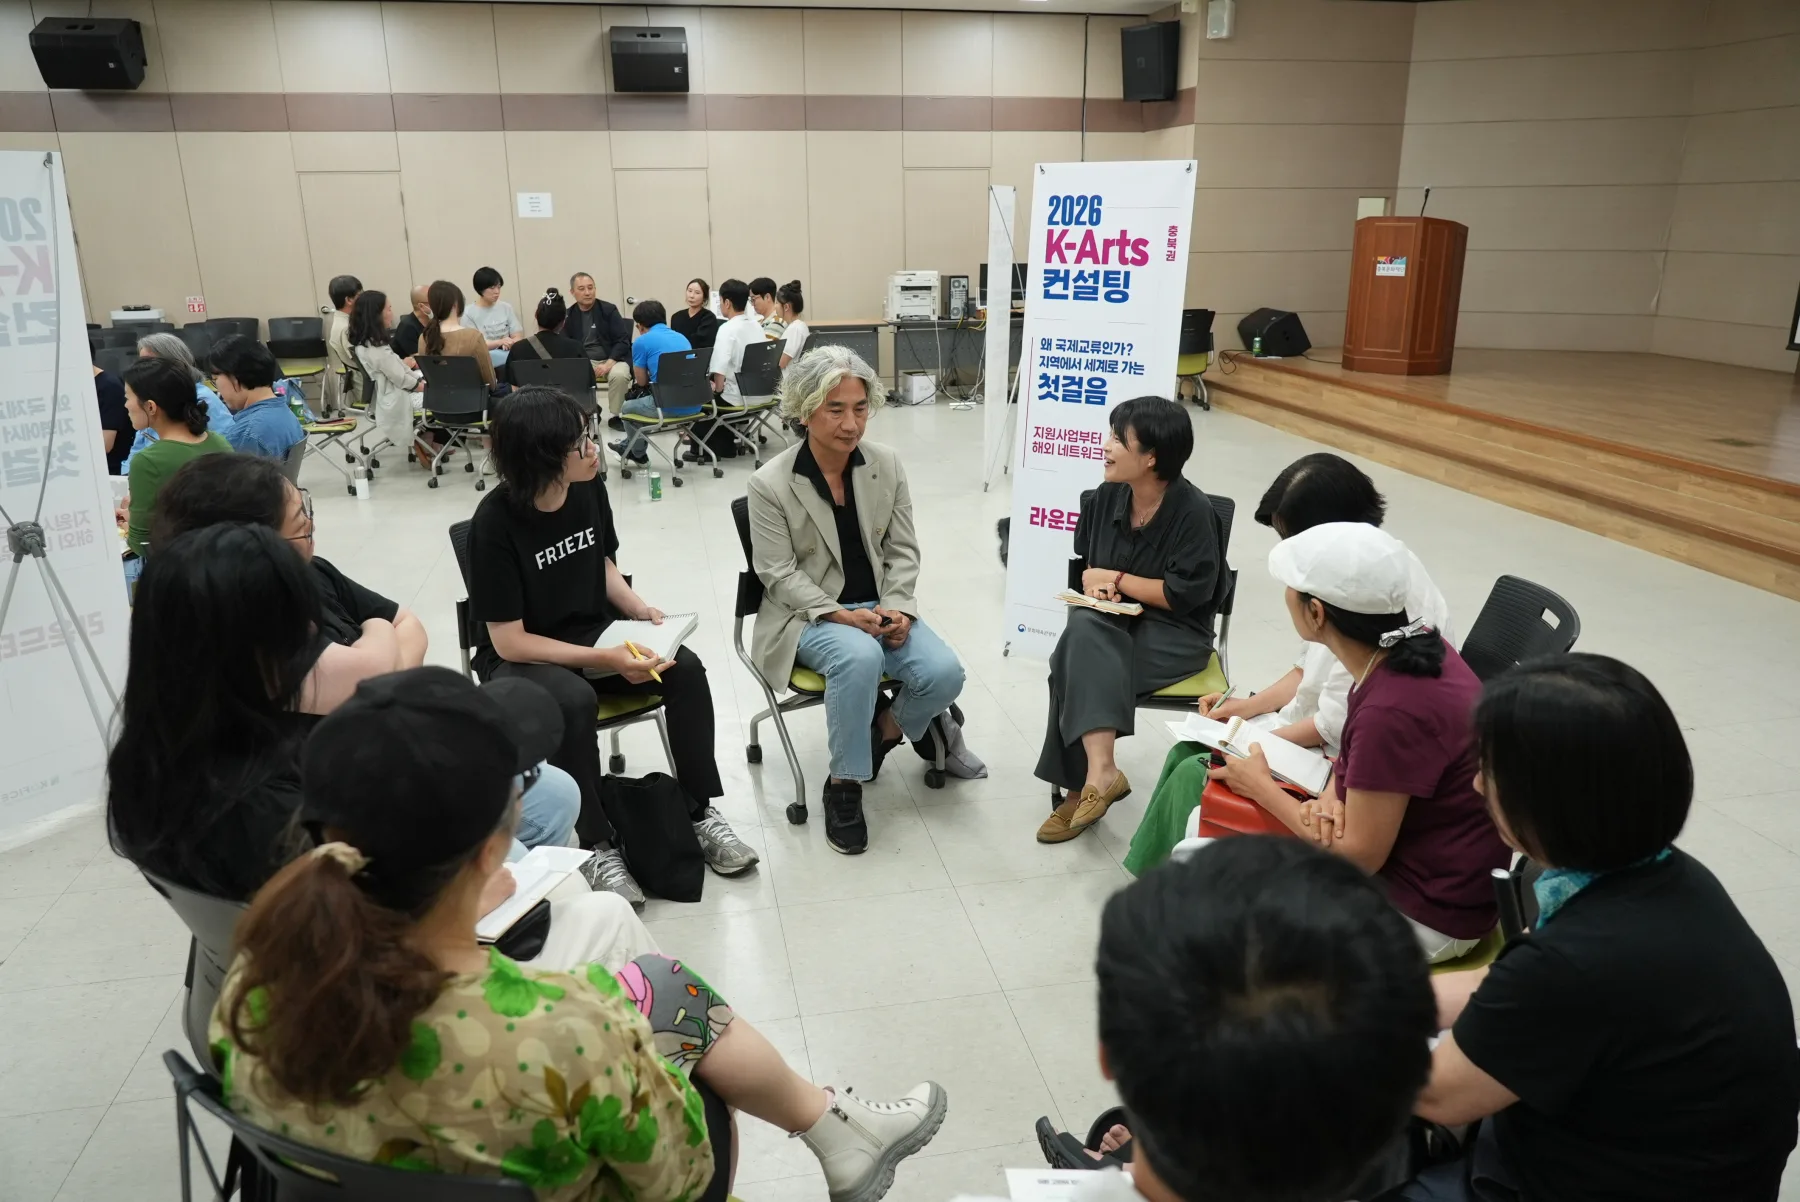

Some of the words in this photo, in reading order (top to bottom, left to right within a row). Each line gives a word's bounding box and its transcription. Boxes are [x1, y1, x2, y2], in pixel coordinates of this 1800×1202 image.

[1047, 195, 1102, 225] 2026
[1044, 229, 1150, 267] K-Arts
[1042, 269, 1131, 304] 컨설팅
[1040, 338, 1052, 352] 왜
[1055, 338, 1134, 356] 국제교류인가?
[1039, 356, 1082, 372] 지역에서
[1084, 358, 1119, 374] 세계로
[1121, 361, 1145, 376] 가는
[1037, 373, 1108, 406] 첫걸음
[1032, 441, 1055, 455] 해외
[1057, 444, 1107, 460] 네트워크
[1033, 426, 1102, 445] 지원사업부터
[535, 527, 596, 570] FRIEZE
